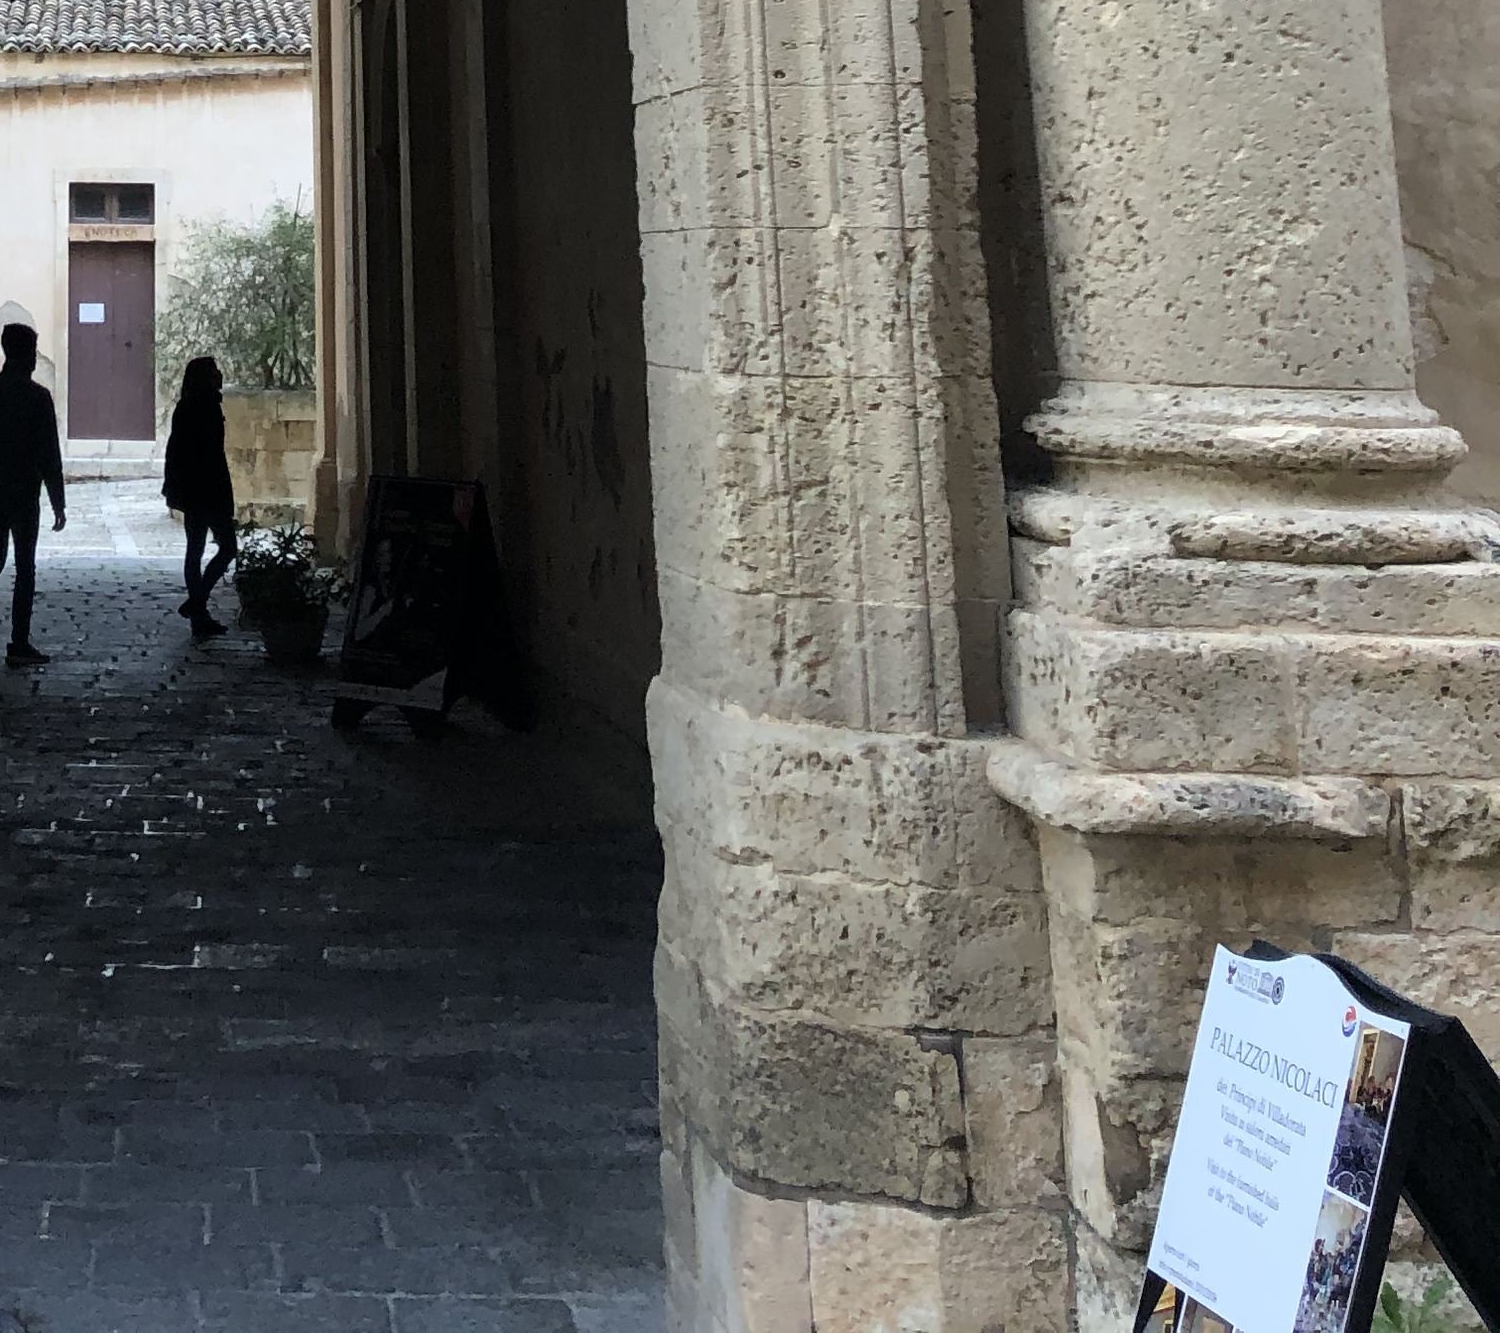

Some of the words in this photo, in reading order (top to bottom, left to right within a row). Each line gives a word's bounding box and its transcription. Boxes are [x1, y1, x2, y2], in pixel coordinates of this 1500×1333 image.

[84, 226, 138, 238] ENOTECA
[1210, 1027, 1270, 1074] PALAZZO
[1270, 1054, 1338, 1108] NICOLACI
